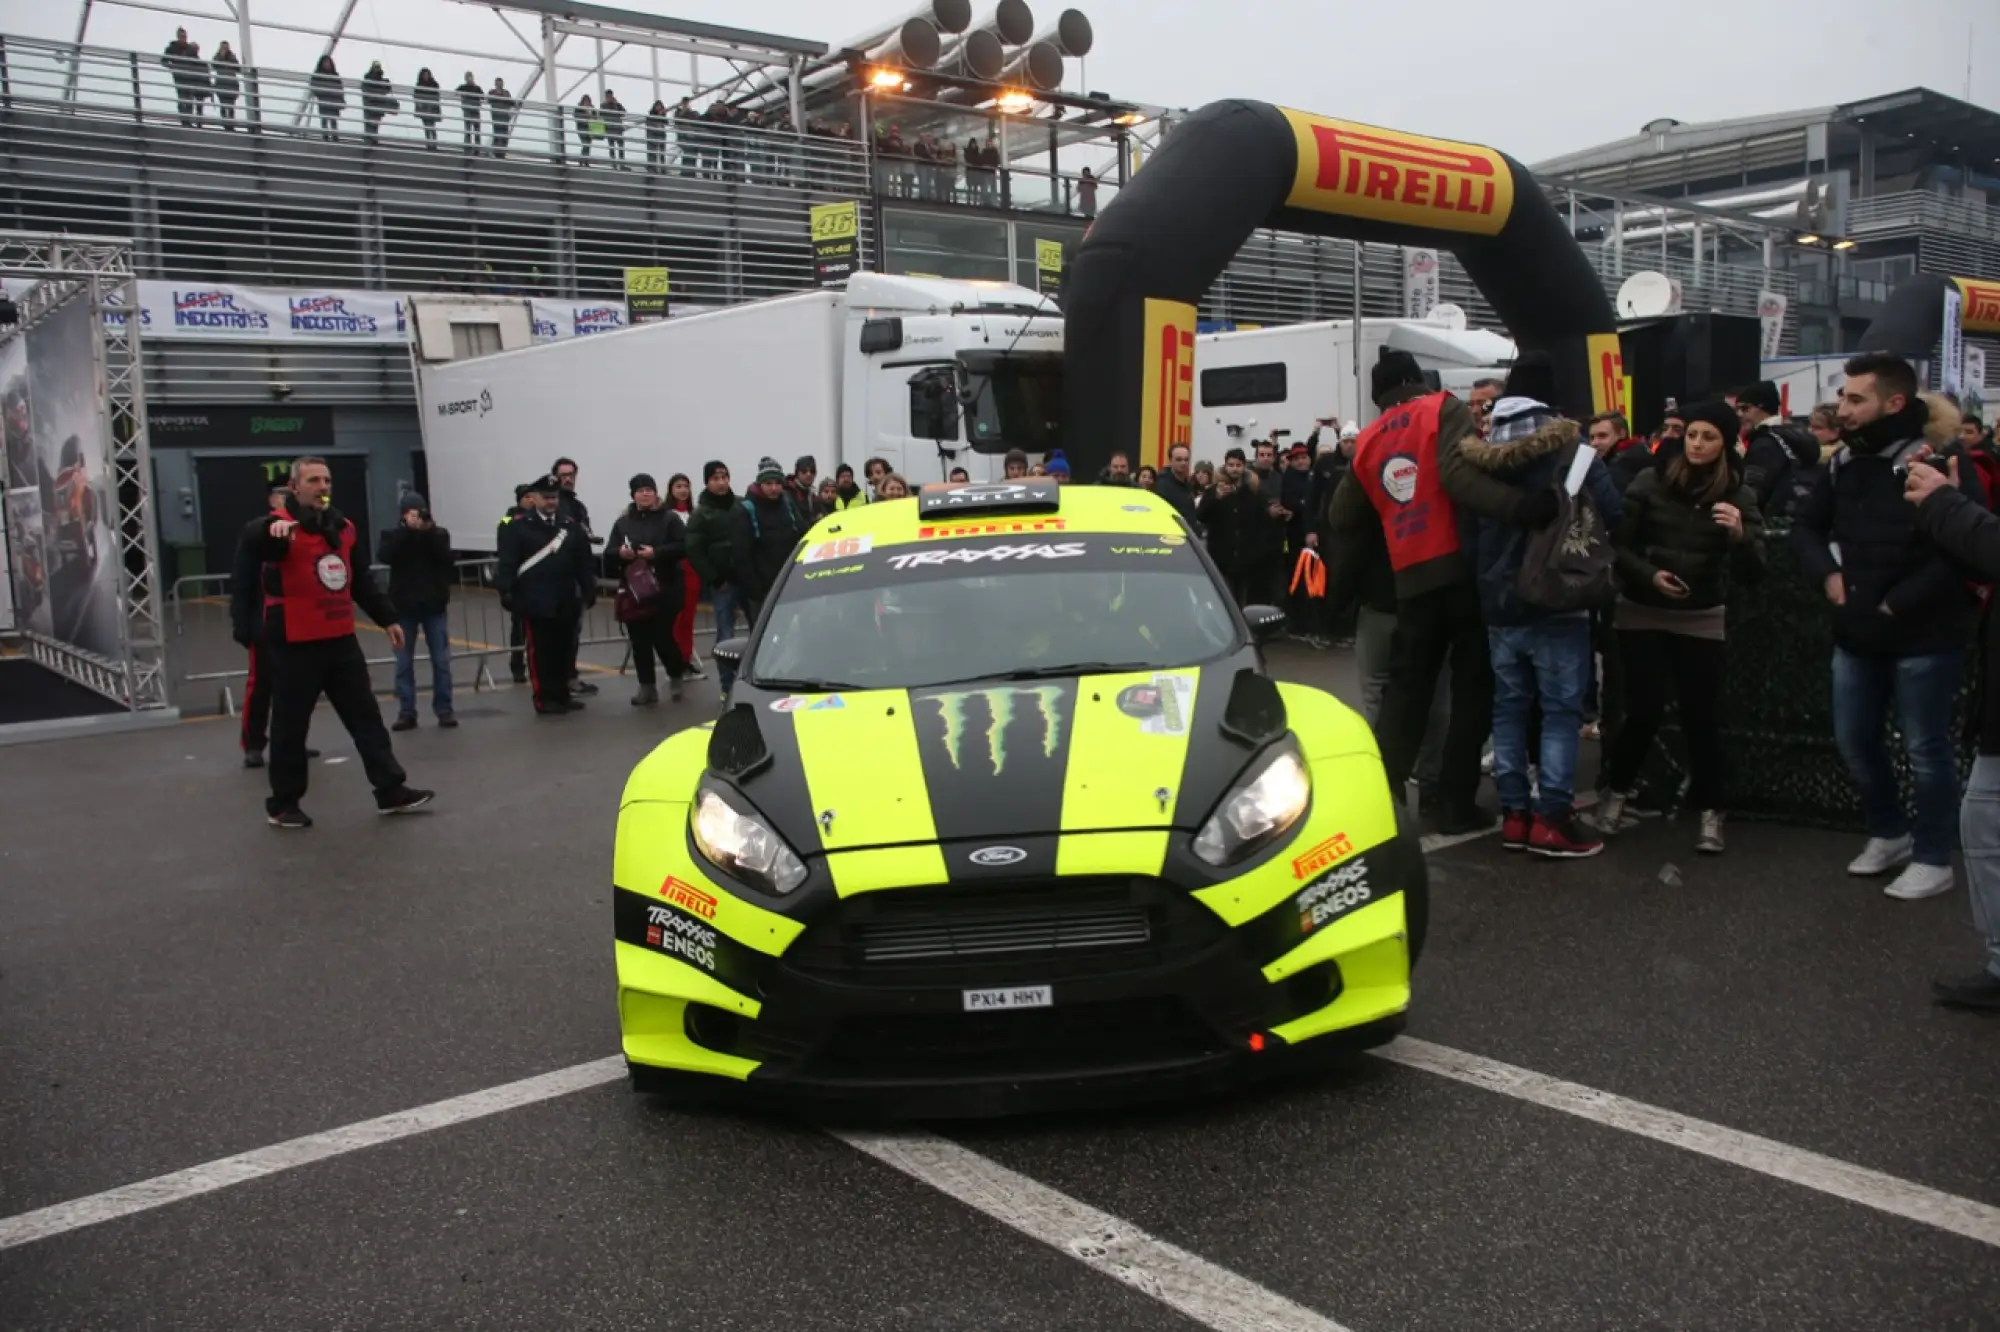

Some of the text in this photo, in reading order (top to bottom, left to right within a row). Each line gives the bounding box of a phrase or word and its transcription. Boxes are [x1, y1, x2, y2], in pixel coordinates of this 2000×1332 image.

[1311, 124, 1494, 215] PIRELLI
[814, 212, 854, 236] 46
[628, 274, 666, 293] 46
[927, 491, 1046, 507] OAKLEY
[814, 537, 861, 560] 46
[886, 541, 1087, 570] TRAXXAS
[1292, 832, 1353, 880] PIRELLI
[659, 874, 718, 920] PIRELLI
[1296, 857, 1368, 912] TRAXXAS
[1312, 880, 1371, 925] ENEOS
[647, 905, 717, 948] TRAXXAS
[663, 930, 715, 971] ENEOS
[969, 989, 1044, 1007] PX14 HHY
